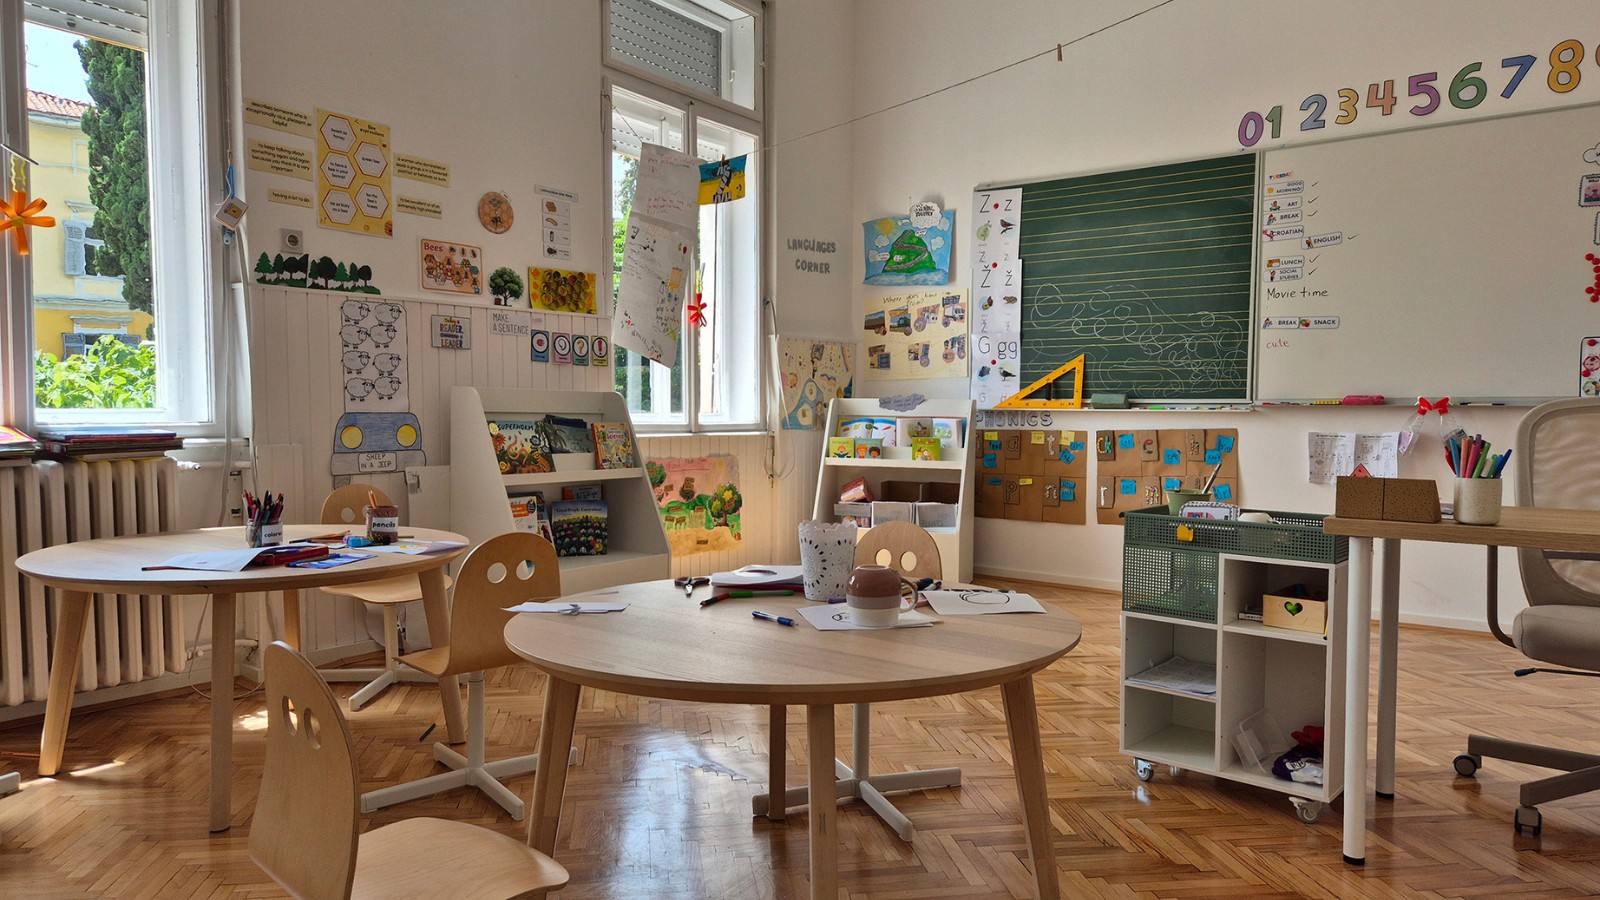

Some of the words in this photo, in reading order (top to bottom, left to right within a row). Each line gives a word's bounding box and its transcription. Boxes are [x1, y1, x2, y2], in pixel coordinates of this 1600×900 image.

[1238, 111, 1263, 147] 0
[1265, 105, 1282, 138] 1
[1300, 94, 1327, 131] 2
[1334, 88, 1359, 124] 3
[1366, 80, 1396, 116] 4
[1408, 72, 1440, 116] 5
[1448, 62, 1487, 109] 6
[1500, 54, 1536, 99] 7
[1547, 39, 1584, 93] 8
[979, 194, 991, 213] Z
[1004, 199, 1013, 212] z
[1273, 229, 1303, 237] CROATIAN
[1314, 235, 1341, 244] ENGLISH
[424, 242, 443, 253] Bees
[787, 238, 836, 254] LANGUAGES
[795, 258, 830, 274] CORNER
[980, 264, 992, 288] Ž
[1005, 270, 1013, 287] ž
[1267, 288, 1296, 301] Movie
[1300, 286, 1329, 298] time
[493, 313, 508, 323] MAKE
[493, 323, 498, 332] A
[498, 323, 529, 335] SENTENCE
[441, 339, 463, 348] LEADER
[978, 335, 991, 354] G
[1266, 338, 1290, 349] cute
[498, 423, 534, 431] SUPERWORM
[366, 453, 387, 461] SHEEP
[378, 460, 392, 469] JEEP
[372, 521, 396, 529] pencils
